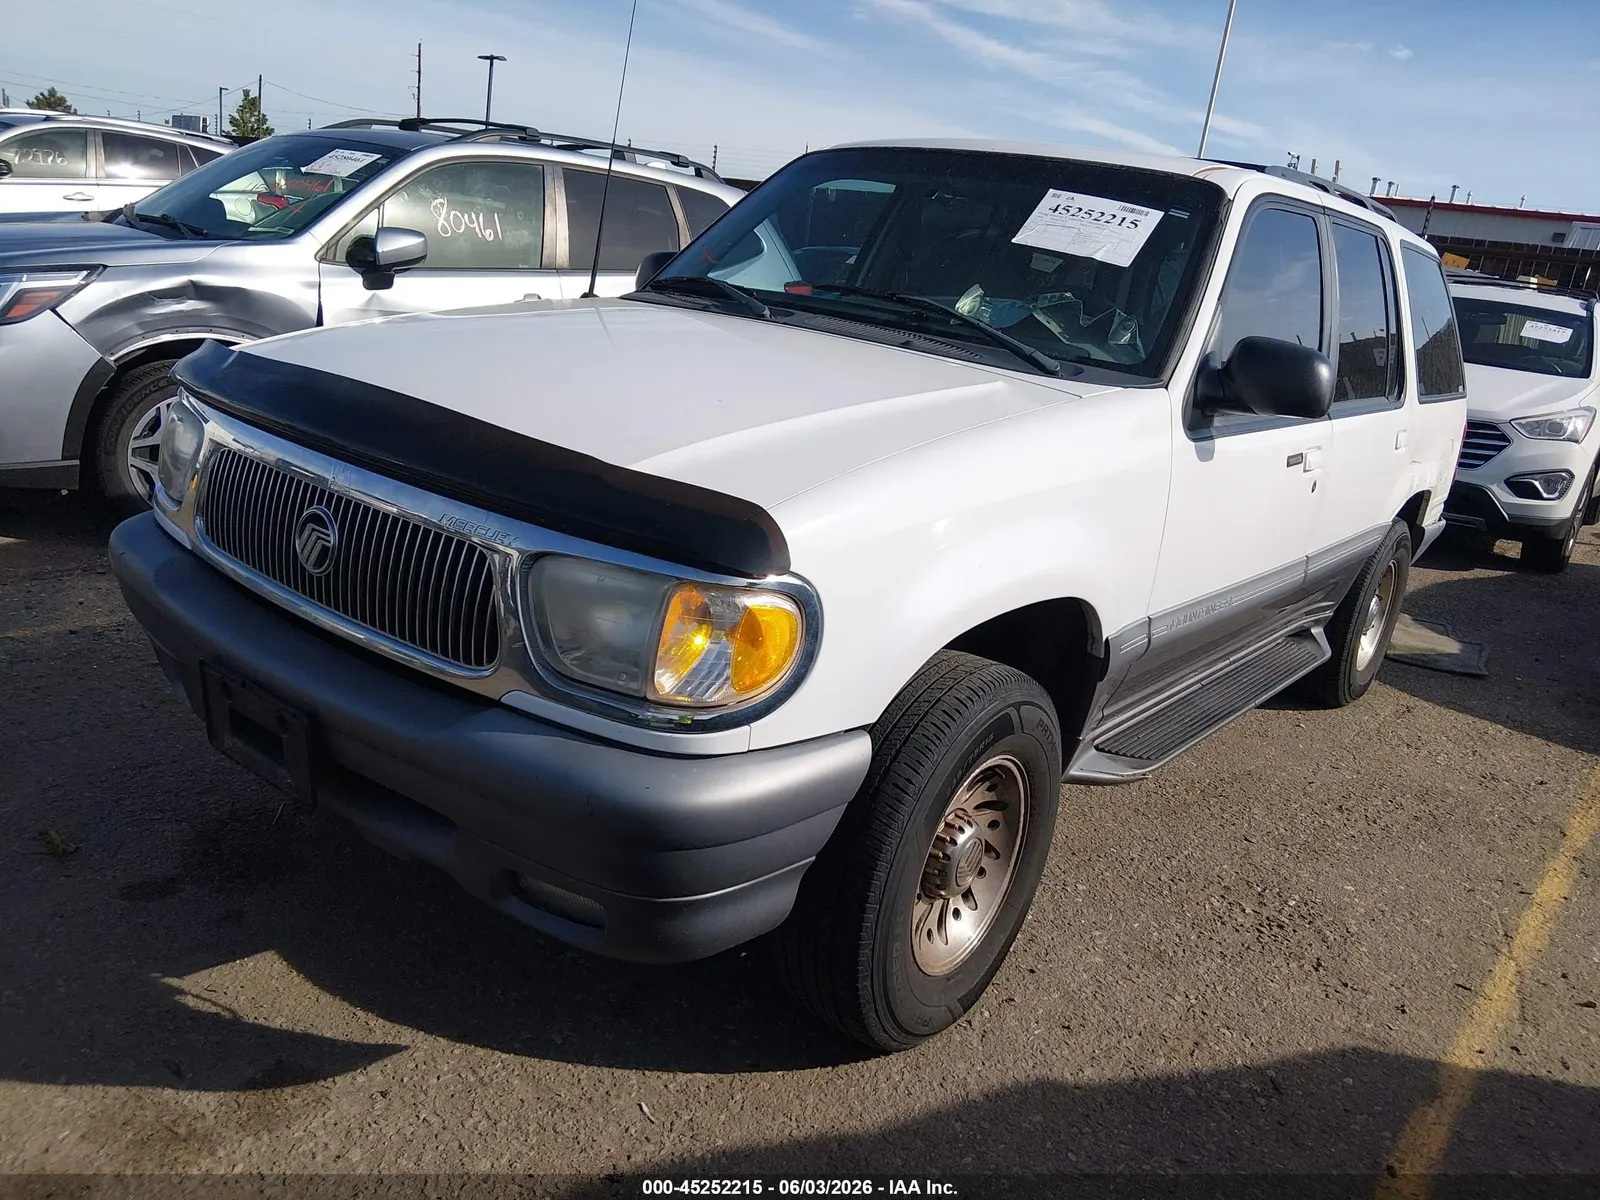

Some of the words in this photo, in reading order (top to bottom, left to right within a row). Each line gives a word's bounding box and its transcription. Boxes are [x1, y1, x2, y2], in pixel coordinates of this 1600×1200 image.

[431, 197, 503, 241] 80461
[1049, 203, 1142, 230] 45252215
[440, 513, 519, 546] MERCURY
